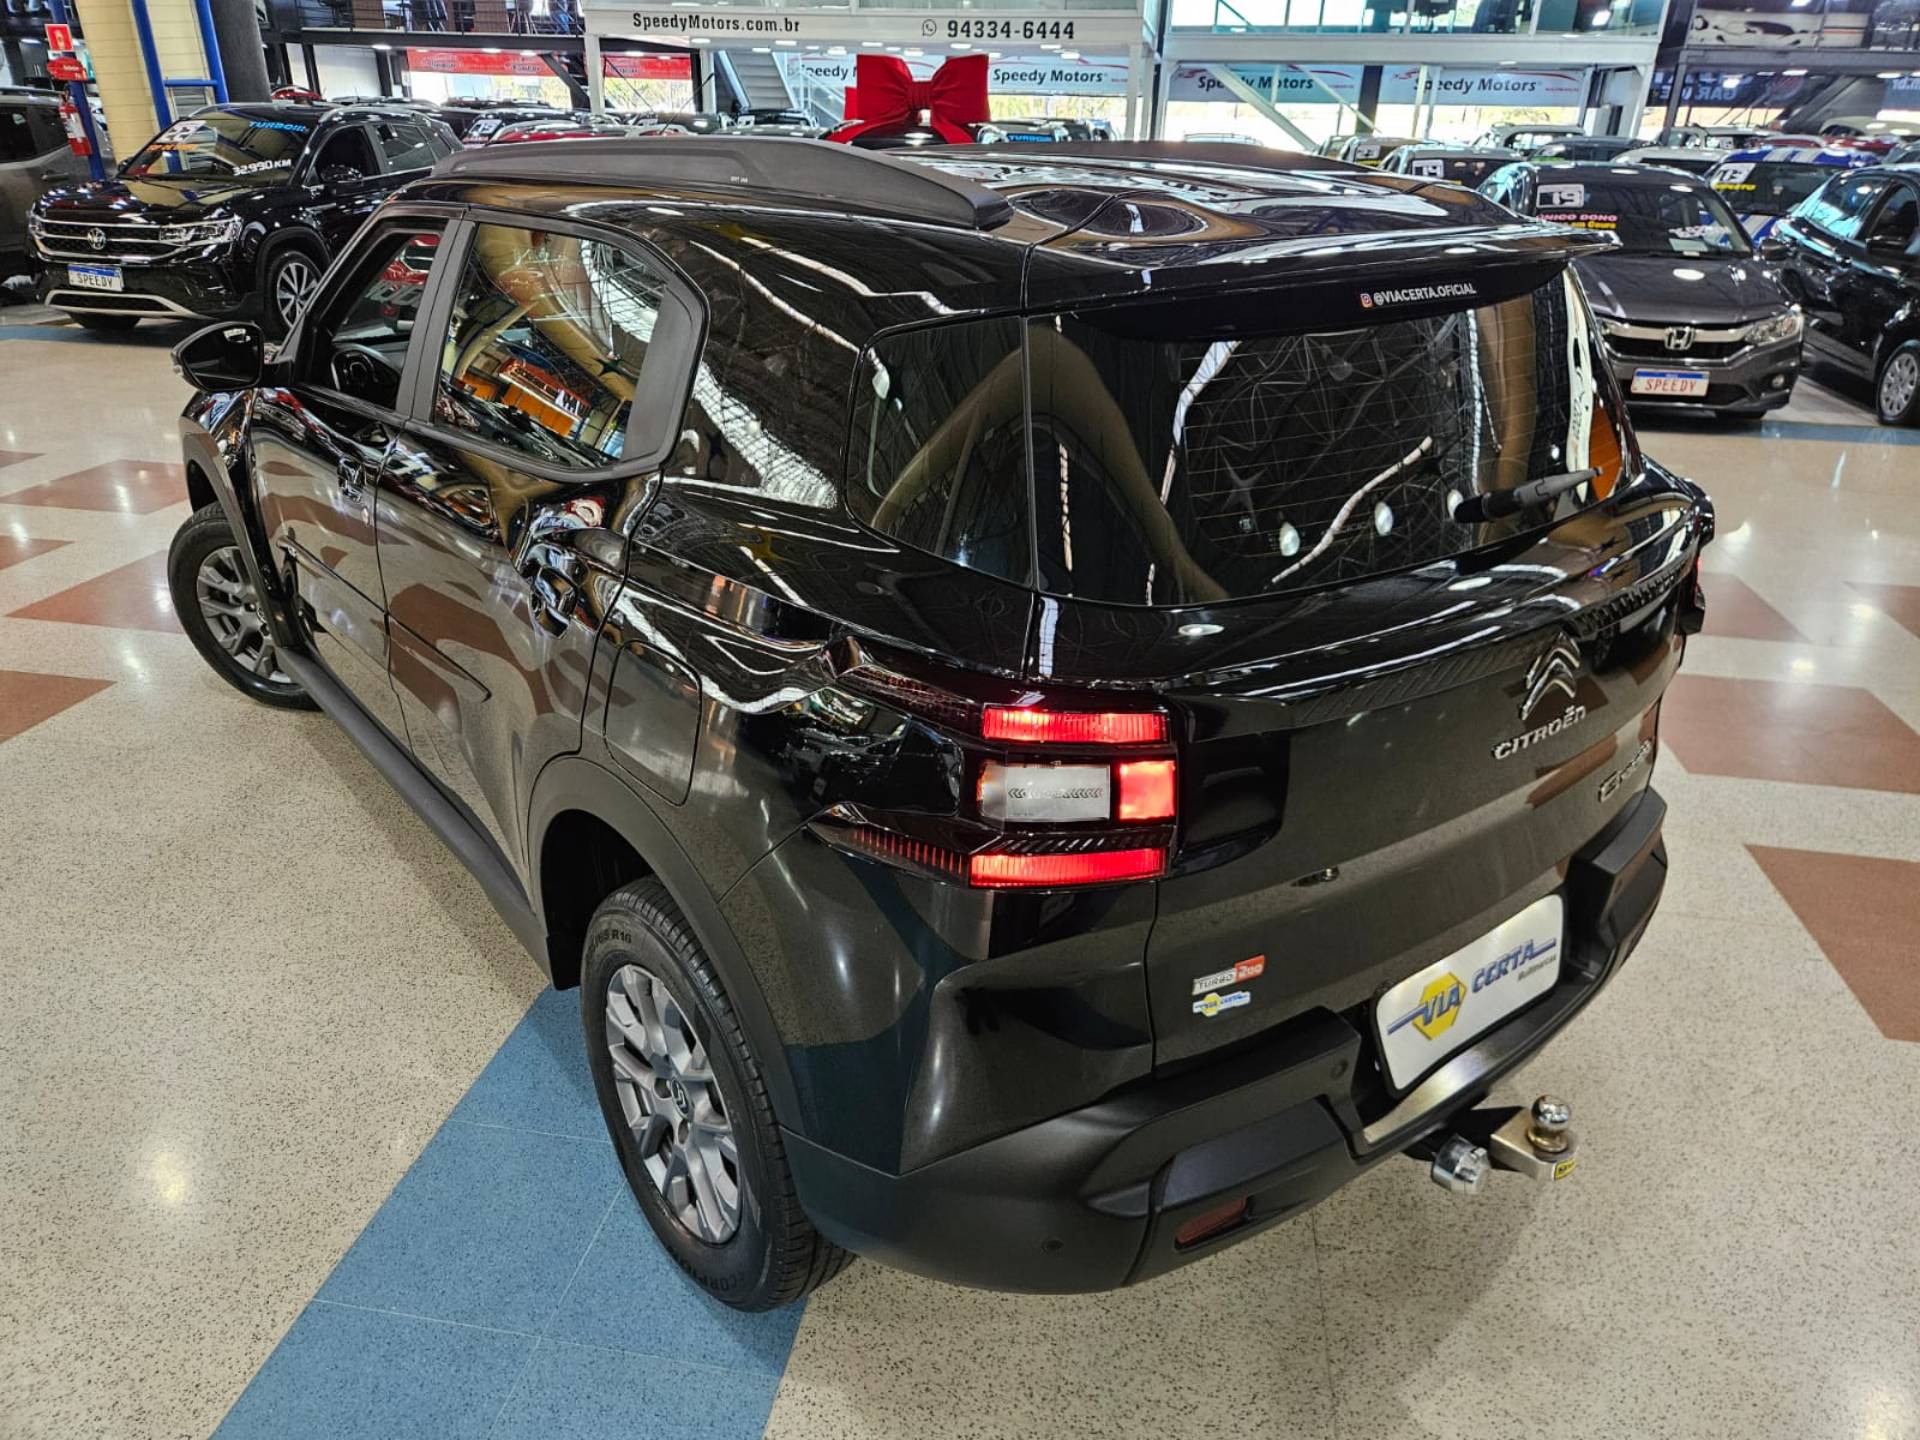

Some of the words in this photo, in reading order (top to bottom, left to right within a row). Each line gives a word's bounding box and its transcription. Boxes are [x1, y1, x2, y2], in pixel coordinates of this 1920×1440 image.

[632, 12, 800, 32] SpeedyMotors.com.br
[947, 19, 1075, 39] 94334-6444
[993, 68, 1046, 86] Speedy
[1051, 69, 1103, 83] Motors
[1477, 78, 1537, 92] Motors
[274, 159, 292, 168] KM
[1374, 283, 1477, 306] @VIACERTA.OFICIAL
[1645, 378, 1697, 393] SPEEDY
[1422, 981, 1462, 1026] VIA
[1471, 939, 1537, 994] CERTA
